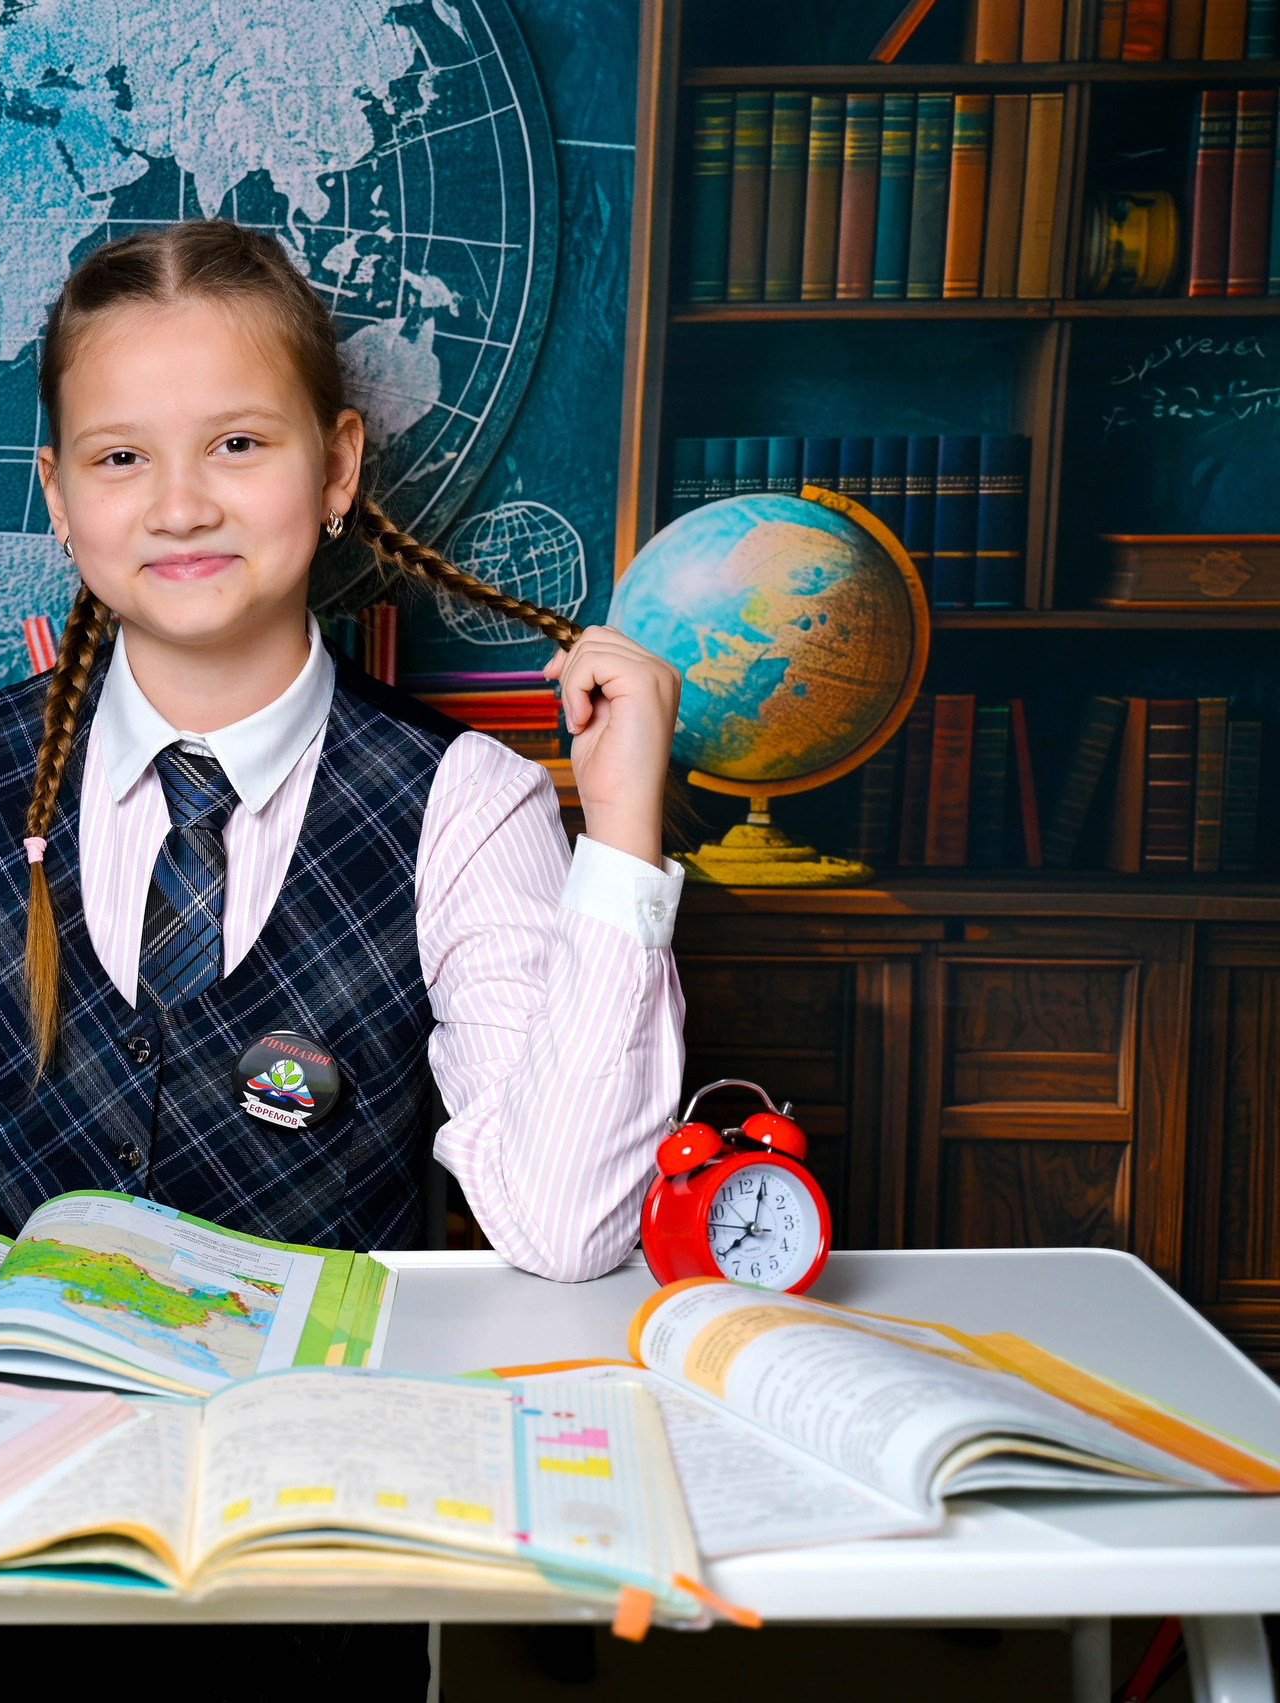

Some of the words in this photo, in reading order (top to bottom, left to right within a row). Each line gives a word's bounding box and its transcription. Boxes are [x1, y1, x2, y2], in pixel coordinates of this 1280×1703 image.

[260, 1036, 332, 1066] ГИМНАЗИЯ
[248, 1103, 299, 1126] ЕФРЕМОВ
[721, 1187, 735, 1202] 11
[738, 1179, 754, 1195] 12
[761, 1181, 768, 1196] 1
[776, 1194, 785, 1210] 2
[710, 1204, 724, 1221] 10
[784, 1214, 794, 1231] 3
[707, 1226, 717, 1243] 9
[780, 1237, 789, 1252] 4
[716, 1246, 727, 1263] 8
[769, 1254, 779, 1270] 5
[732, 1260, 741, 1276] 7
[751, 1262, 761, 1278] 6
